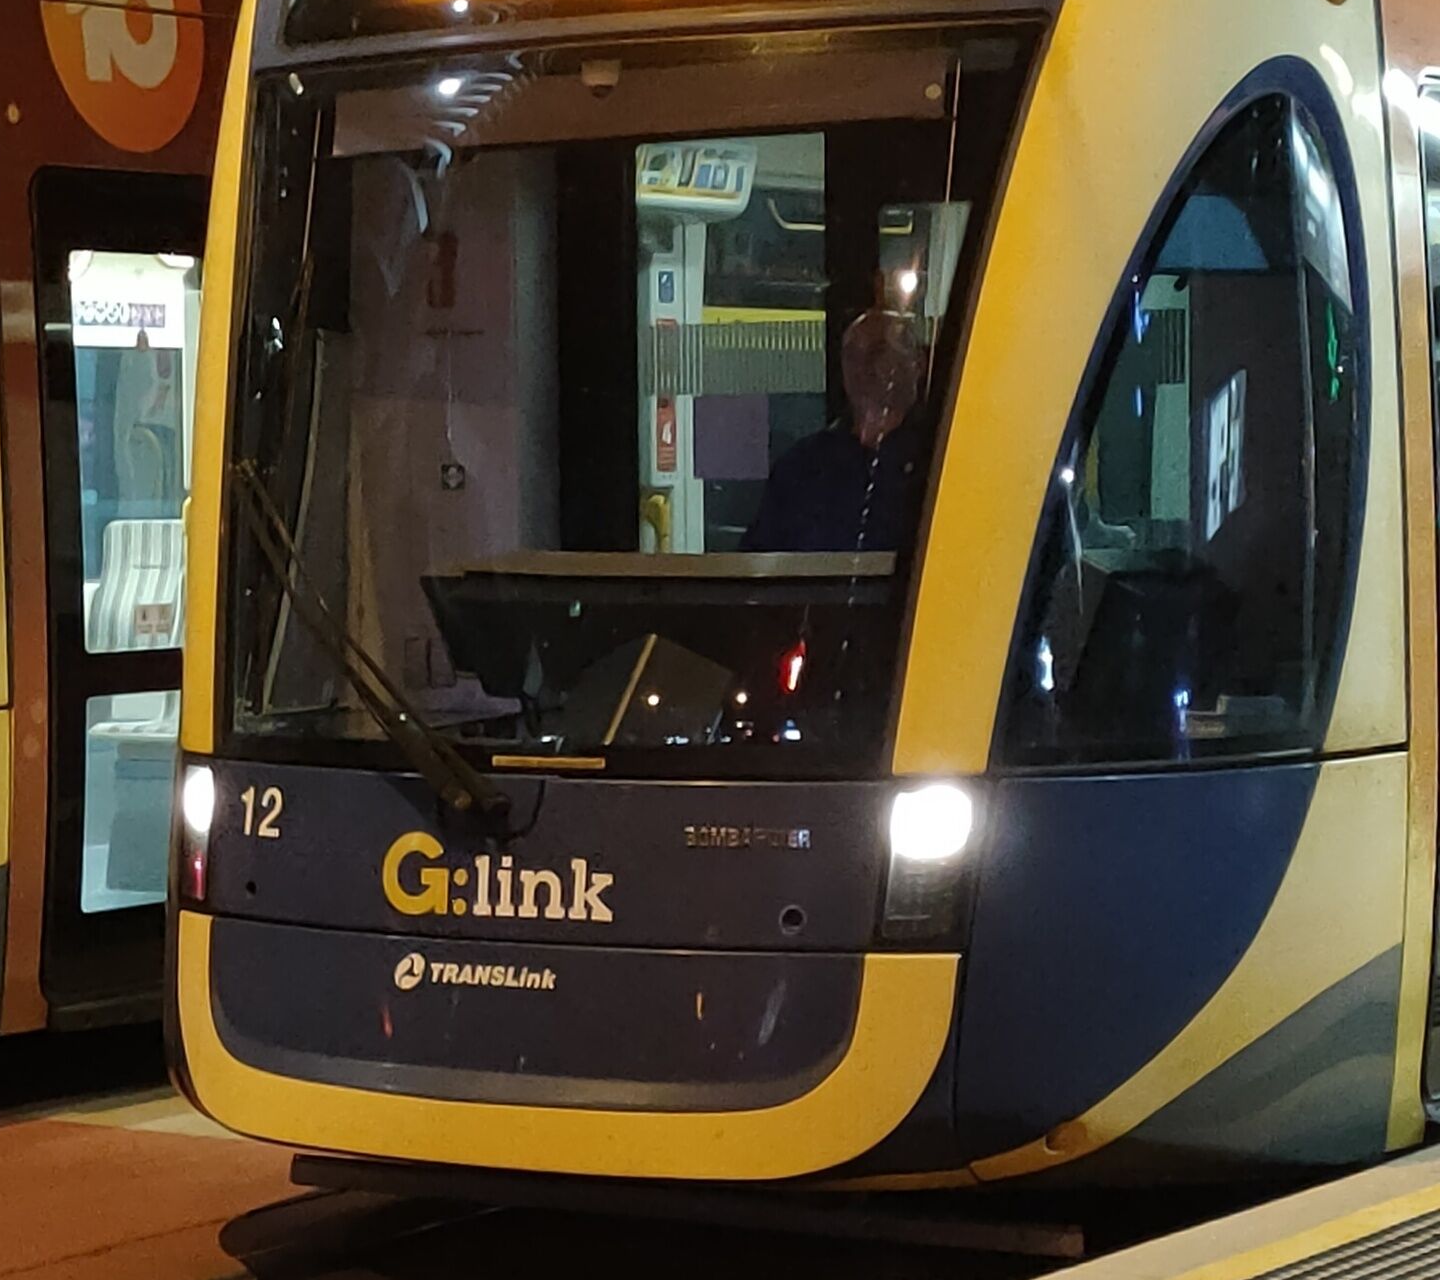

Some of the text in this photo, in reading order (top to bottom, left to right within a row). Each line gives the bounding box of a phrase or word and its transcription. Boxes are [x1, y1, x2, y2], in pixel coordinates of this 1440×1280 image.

[241, 786, 283, 838] 12
[684, 826, 811, 849] BOMBAER
[382, 831, 614, 923] G:link
[429, 962, 557, 990] TRANSLink
